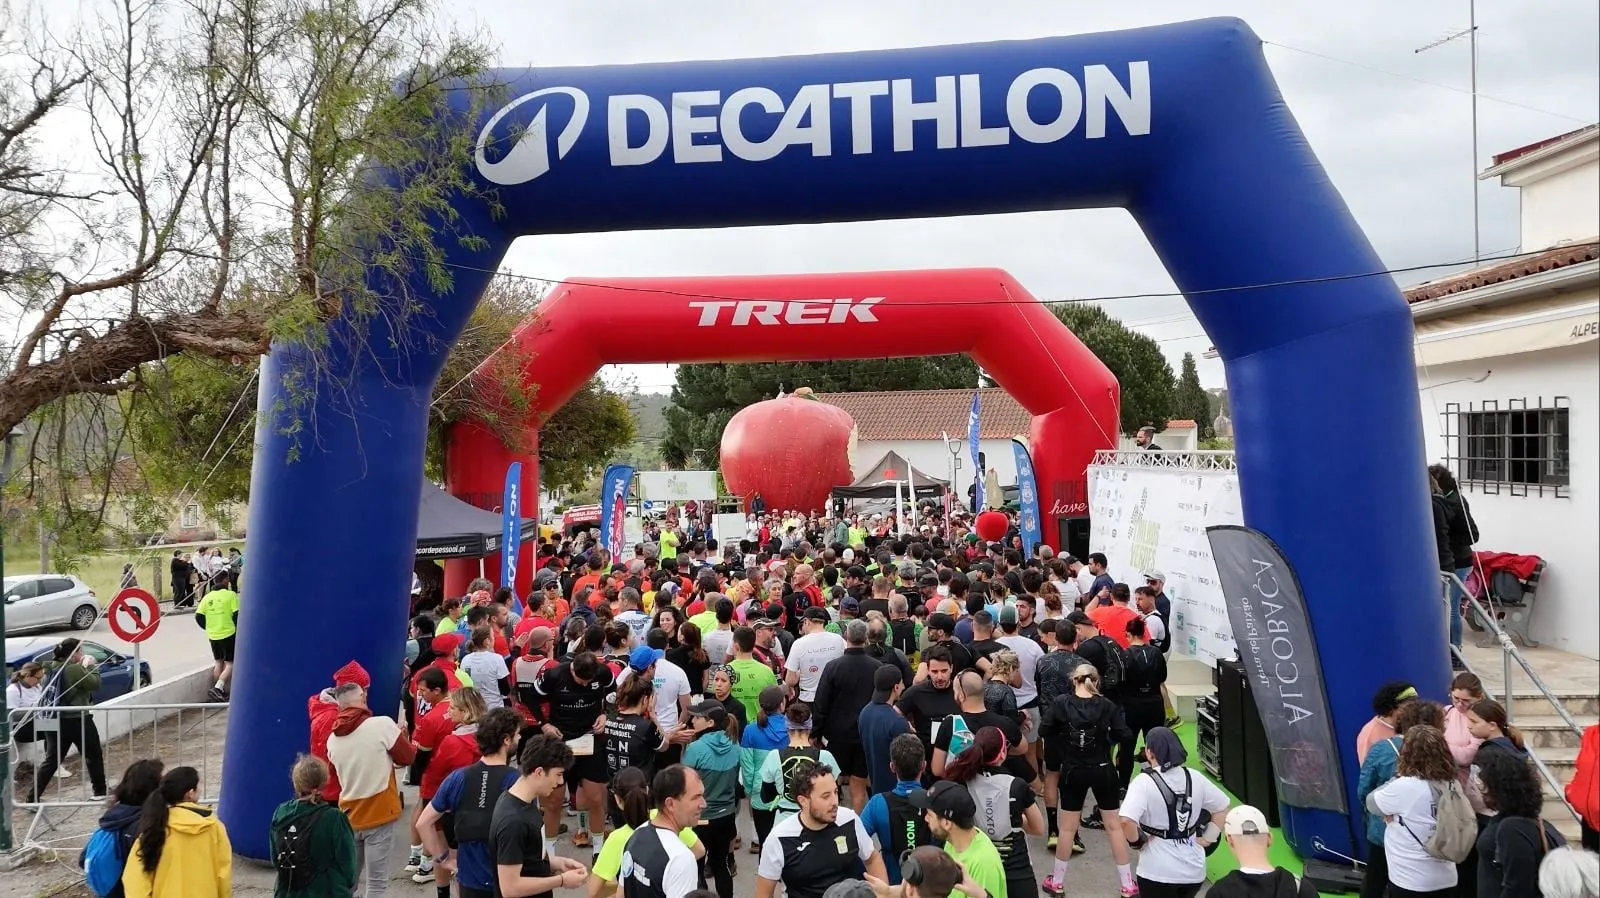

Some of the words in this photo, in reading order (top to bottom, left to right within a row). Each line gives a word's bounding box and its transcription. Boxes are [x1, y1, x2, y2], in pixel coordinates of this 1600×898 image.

[607, 60, 1152, 167] DECATHLON
[688, 296, 887, 328] TREK
[1048, 499, 1088, 515] have
